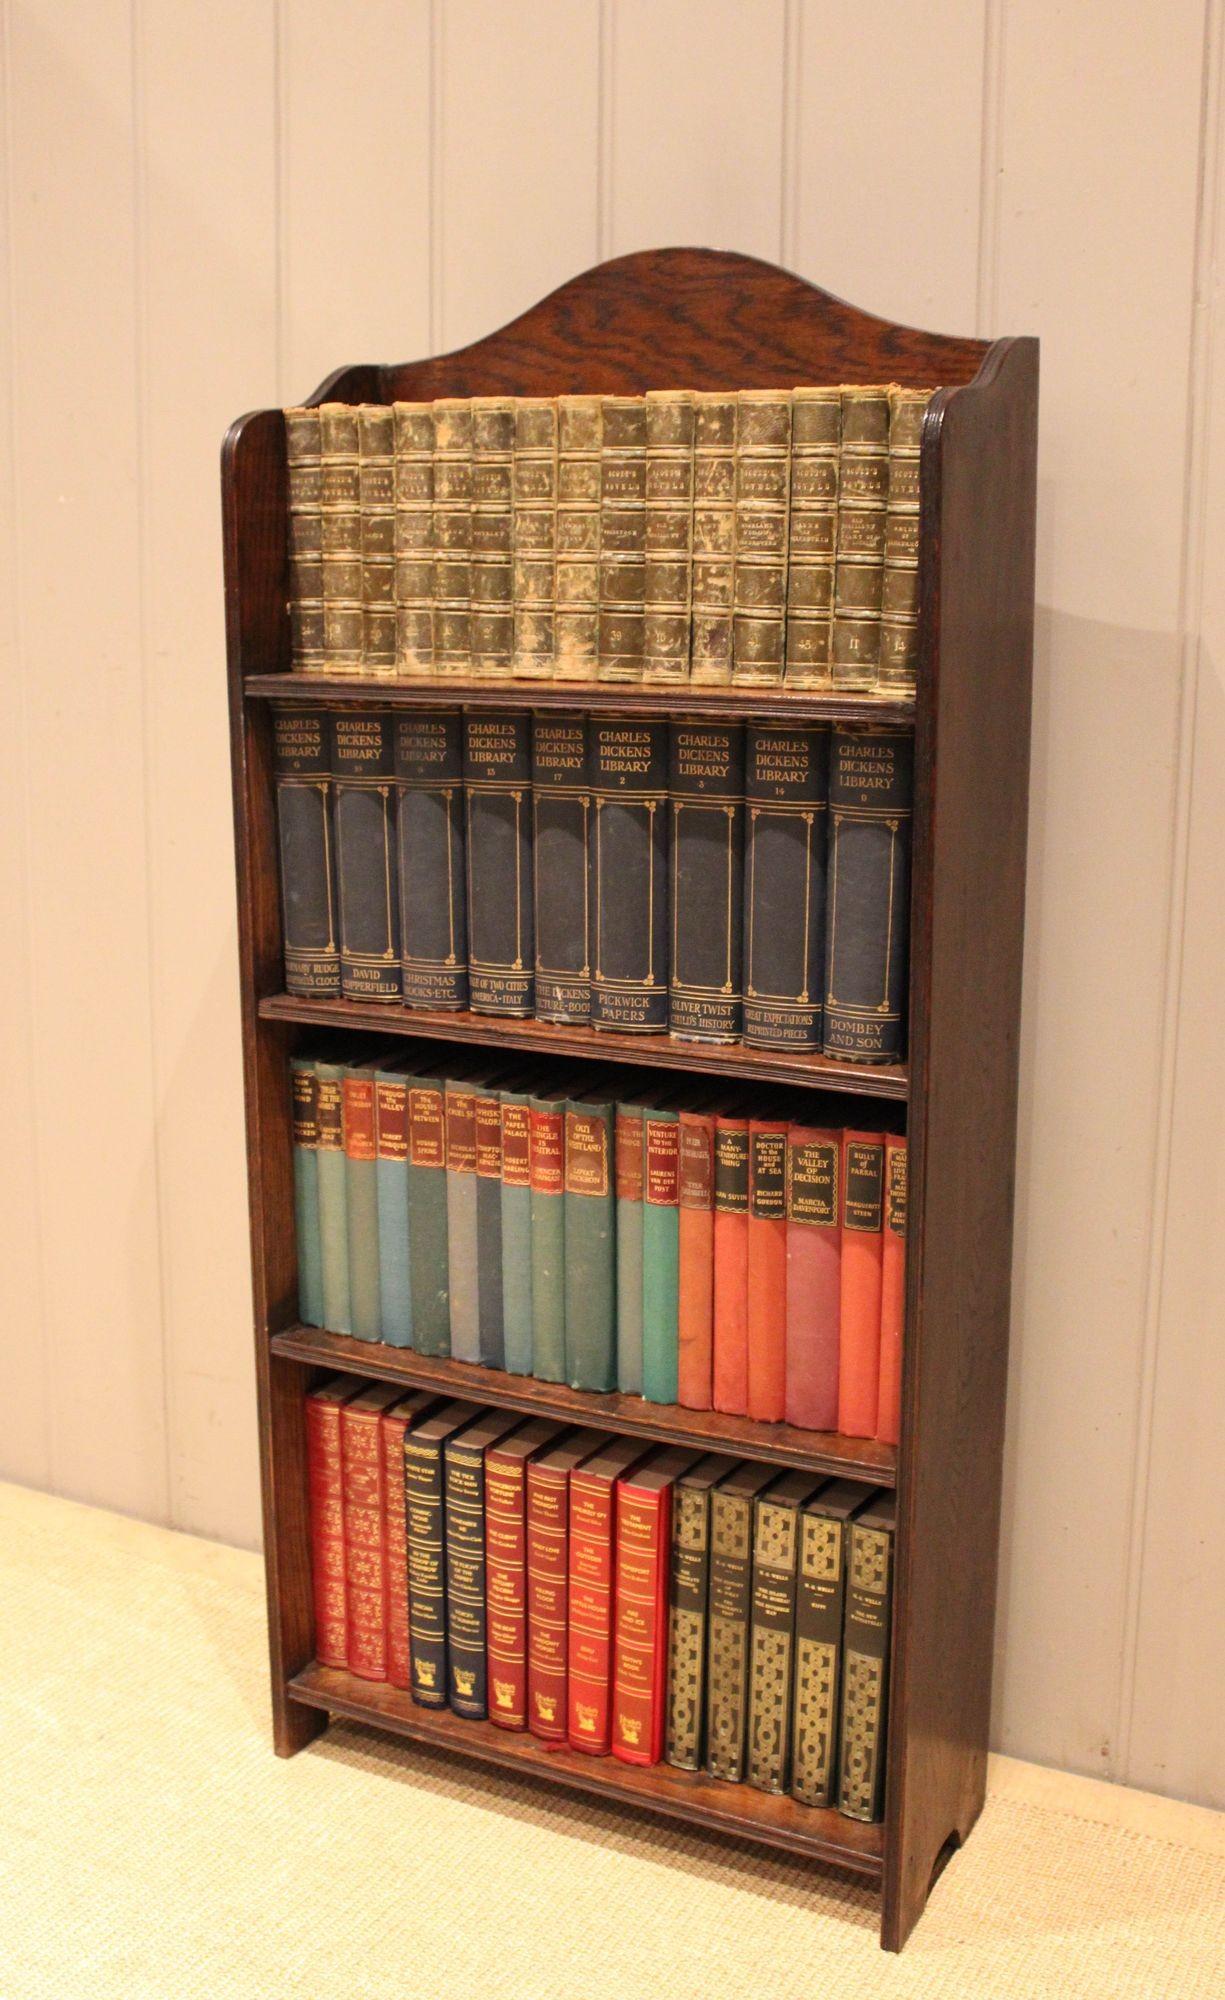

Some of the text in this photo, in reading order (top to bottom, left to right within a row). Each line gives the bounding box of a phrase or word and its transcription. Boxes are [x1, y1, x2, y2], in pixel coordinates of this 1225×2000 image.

[275, 720, 320, 729] CHARLES
[337, 722, 381, 732] CHARLES
[400, 724, 446, 734] CHARLES
[468, 724, 515, 736] CHARLES
[276, 733, 320, 743] DICKENS
[535, 728, 583, 740] CHARLES
[599, 731, 651, 743] CHARLES
[337, 735, 381, 745] DICKENS
[400, 737, 446, 747] DICKENS
[469, 738, 516, 749] DICKENS
[679, 735, 729, 747] CHARLES
[278, 746, 320, 757] LIBRARY
[536, 743, 583, 753] DICKENS
[601, 746, 651, 757] DICKENS
[756, 740, 808, 752] CHARLES
[338, 749, 382, 759] LIBRARY
[401, 751, 446, 761] LIBRARY
[470, 752, 516, 763] LIBRARY
[679, 749, 729, 761] DICKENS
[840, 746, 894, 758] CHARLES
[537, 757, 583, 768] LIBRARY
[601, 760, 651, 772] LIBRARY
[757, 756, 808, 767] DICKENS
[840, 760, 894, 773] DICKENS
[680, 764, 729, 777] LIBRARY
[757, 770, 809, 782] LIBRARY
[840, 776, 894, 788] LIBRARY
[353, 969, 380, 979] DAVID
[343, 980, 397, 992] COPPERFIELD
[480, 980, 528, 991] OF TWO CITIES
[599, 994, 649, 1007] PICKWICK
[673, 1000, 732, 1015] OLIVER TWIST
[602, 1008, 645, 1021] PAPERS
[745, 1009, 813, 1025] GREAT EXPECTATIONS
[700, 1018, 735, 1029] HISTORY
[831, 1019, 884, 1034] DOMBEY
[784, 1029, 807, 1039] PIECES
[829, 1034, 883, 1048] AND SON
[381, 1103, 404, 1111] VALLEY
[585, 1144, 601, 1152] LAND
[798, 1158, 829, 1168] VALLEY
[794, 1173, 830, 1184] DECISION
[799, 1198, 825, 1206] MARCIA
[794, 1205, 830, 1214] DAVENPORT
